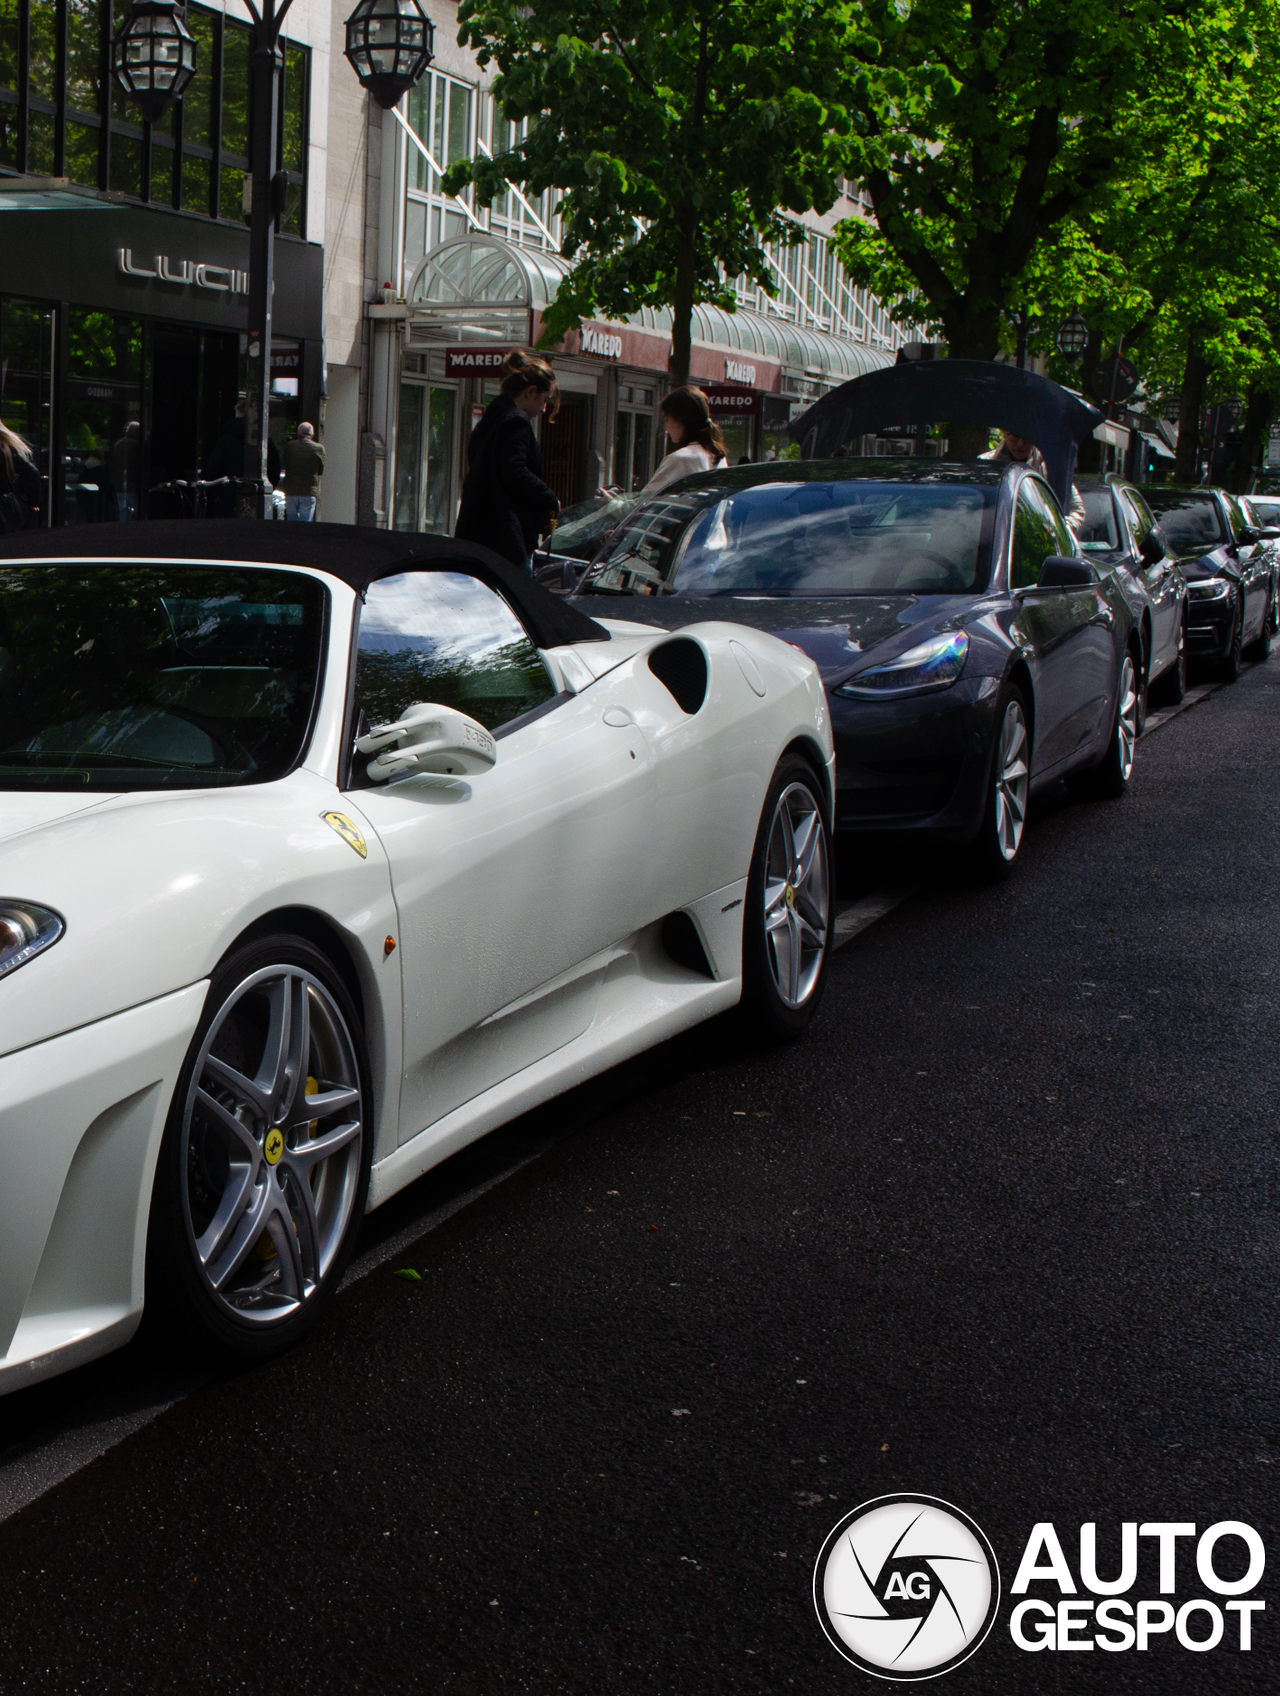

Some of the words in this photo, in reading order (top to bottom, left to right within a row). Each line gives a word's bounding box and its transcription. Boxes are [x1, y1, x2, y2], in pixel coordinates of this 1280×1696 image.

[118, 247, 275, 296] LUCI
[580, 324, 622, 359] MAREDO
[724, 356, 757, 385] MAREDO
[707, 395, 754, 407] MAREDO
